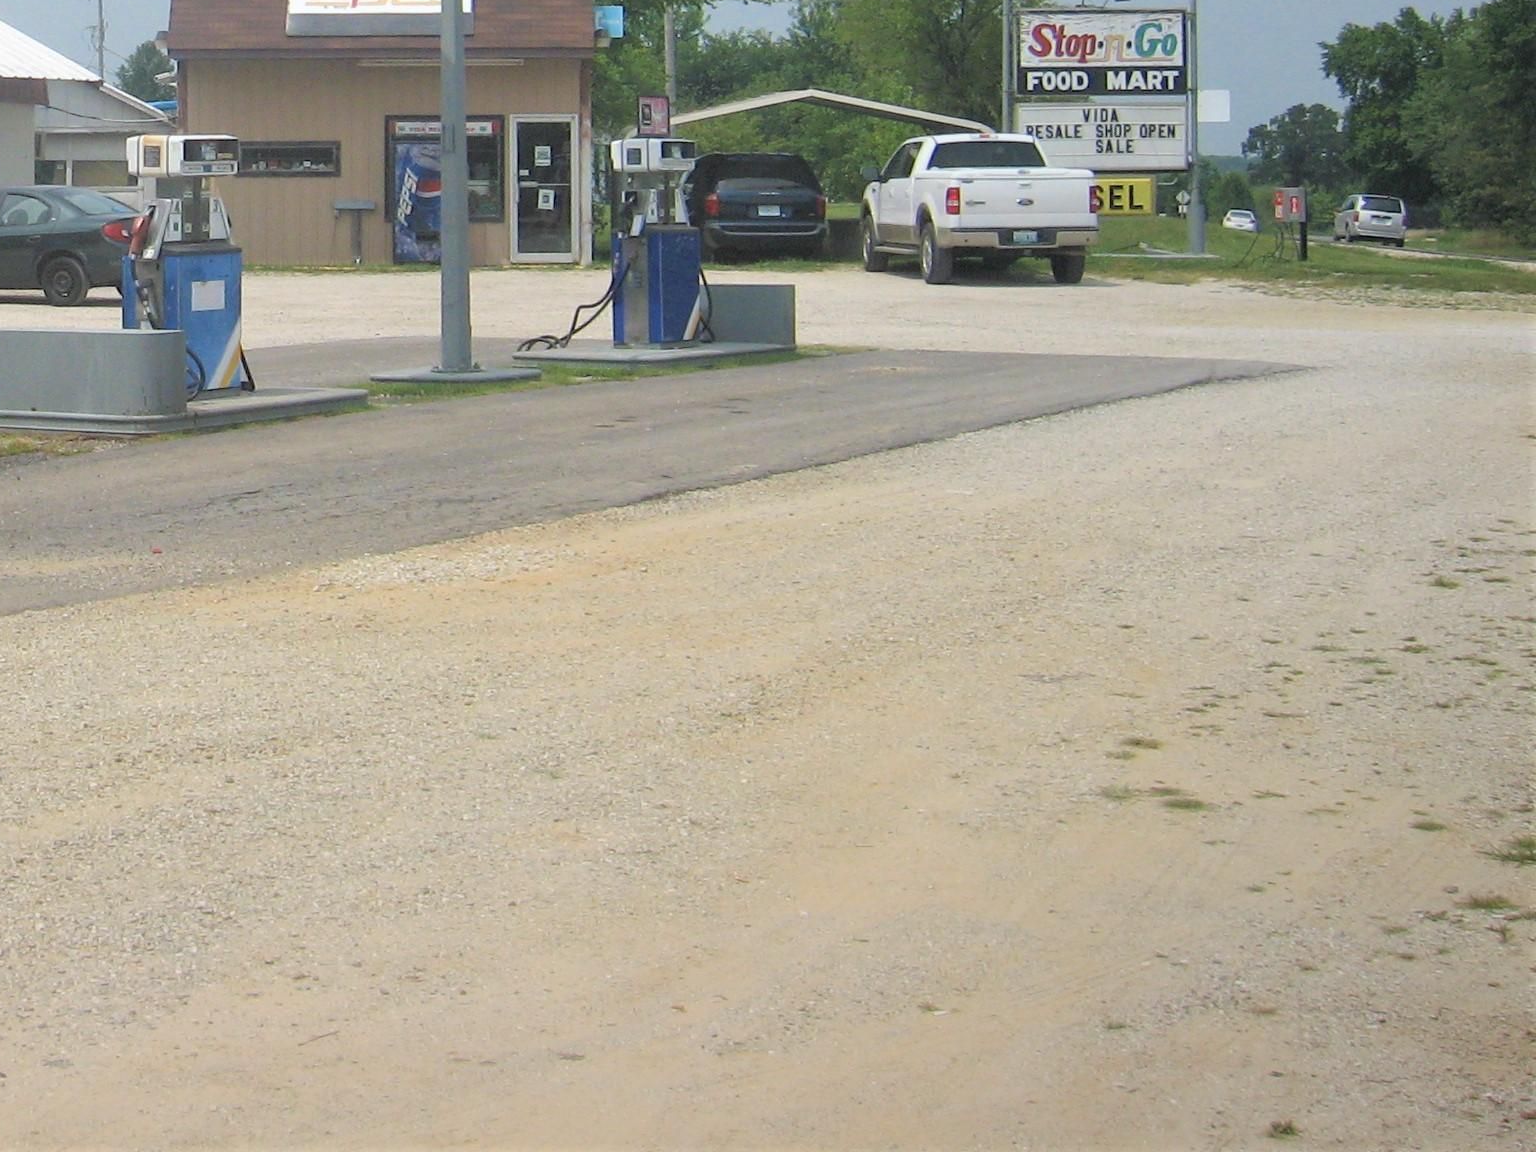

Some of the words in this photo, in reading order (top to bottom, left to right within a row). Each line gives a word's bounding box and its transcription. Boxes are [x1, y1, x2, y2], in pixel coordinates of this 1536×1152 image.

[1026, 71, 1089, 91] FOOD
[1106, 70, 1179, 91] MART
[1082, 108, 1119, 123] VIDA
[1026, 124, 1083, 139] RESALE
[1095, 124, 1132, 139] SHOP
[1139, 124, 1176, 139] OPEN
[1095, 139, 1135, 154] SALE
[397, 168, 419, 227] PEPSI
